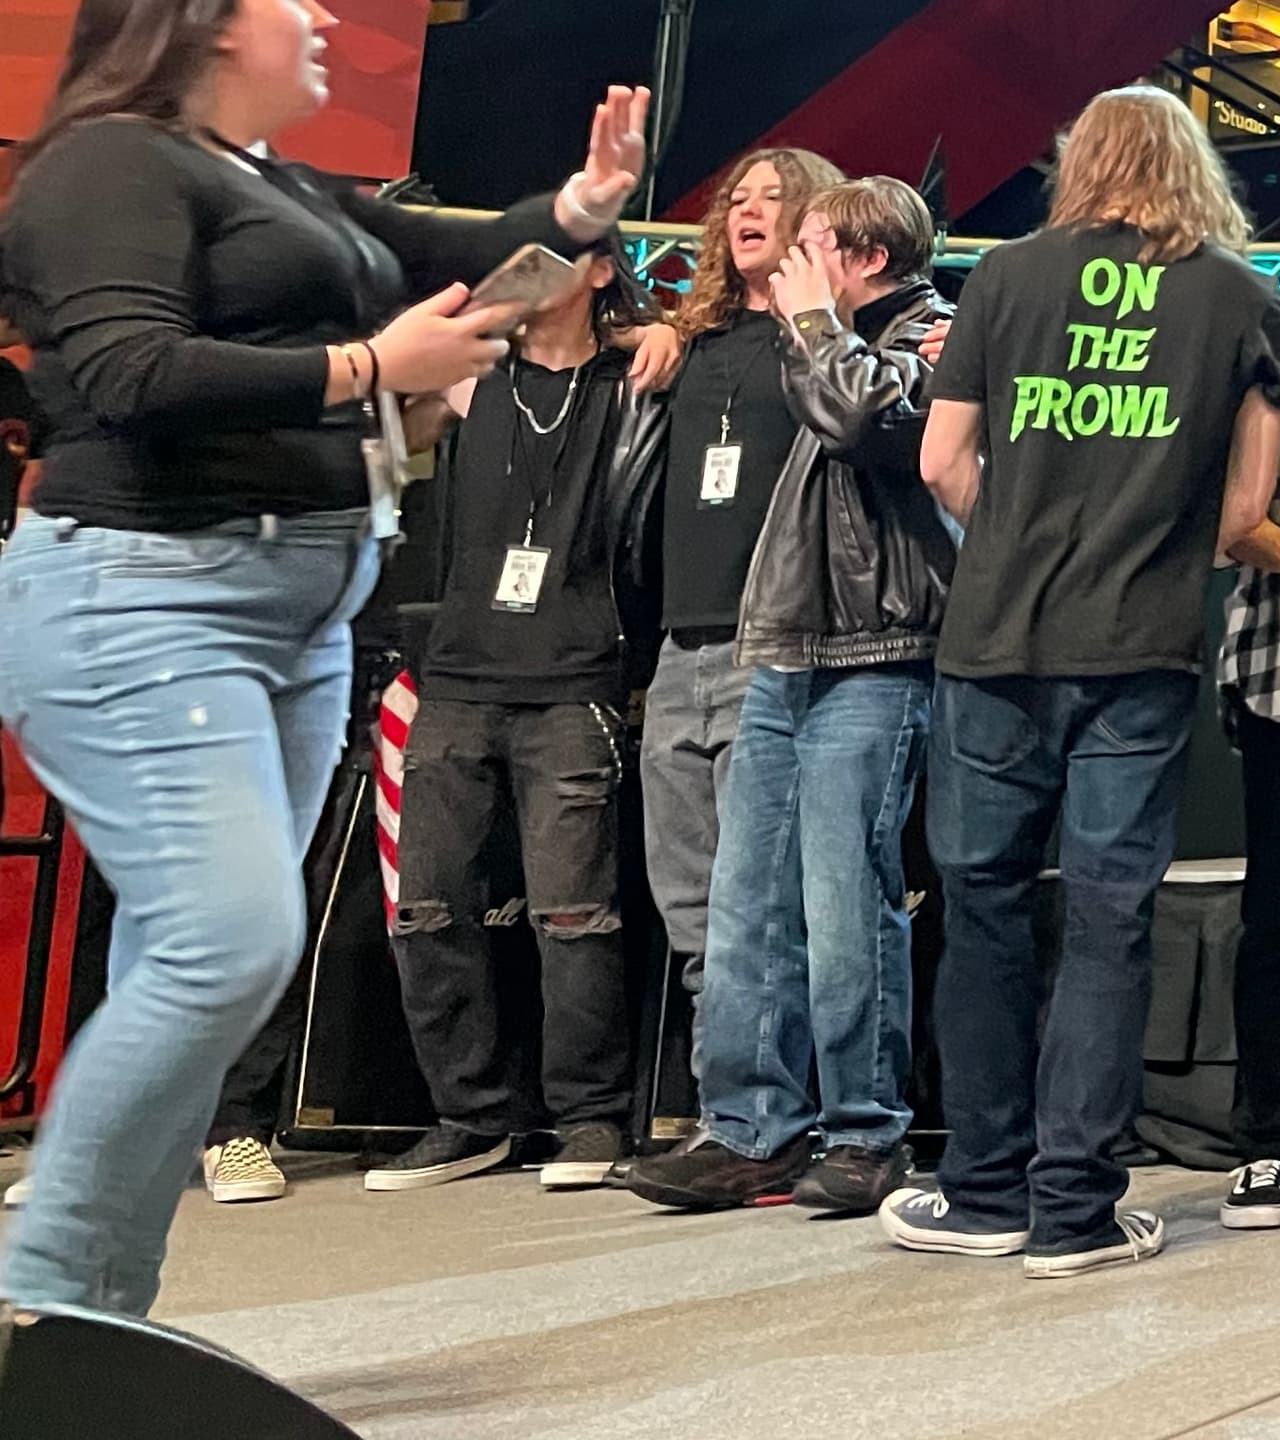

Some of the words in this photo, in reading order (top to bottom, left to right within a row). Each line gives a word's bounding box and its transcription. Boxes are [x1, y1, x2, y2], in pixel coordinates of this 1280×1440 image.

[1081, 258, 1166, 320] ON
[1066, 324, 1157, 372] THE
[1009, 376, 1180, 443] PROWL
